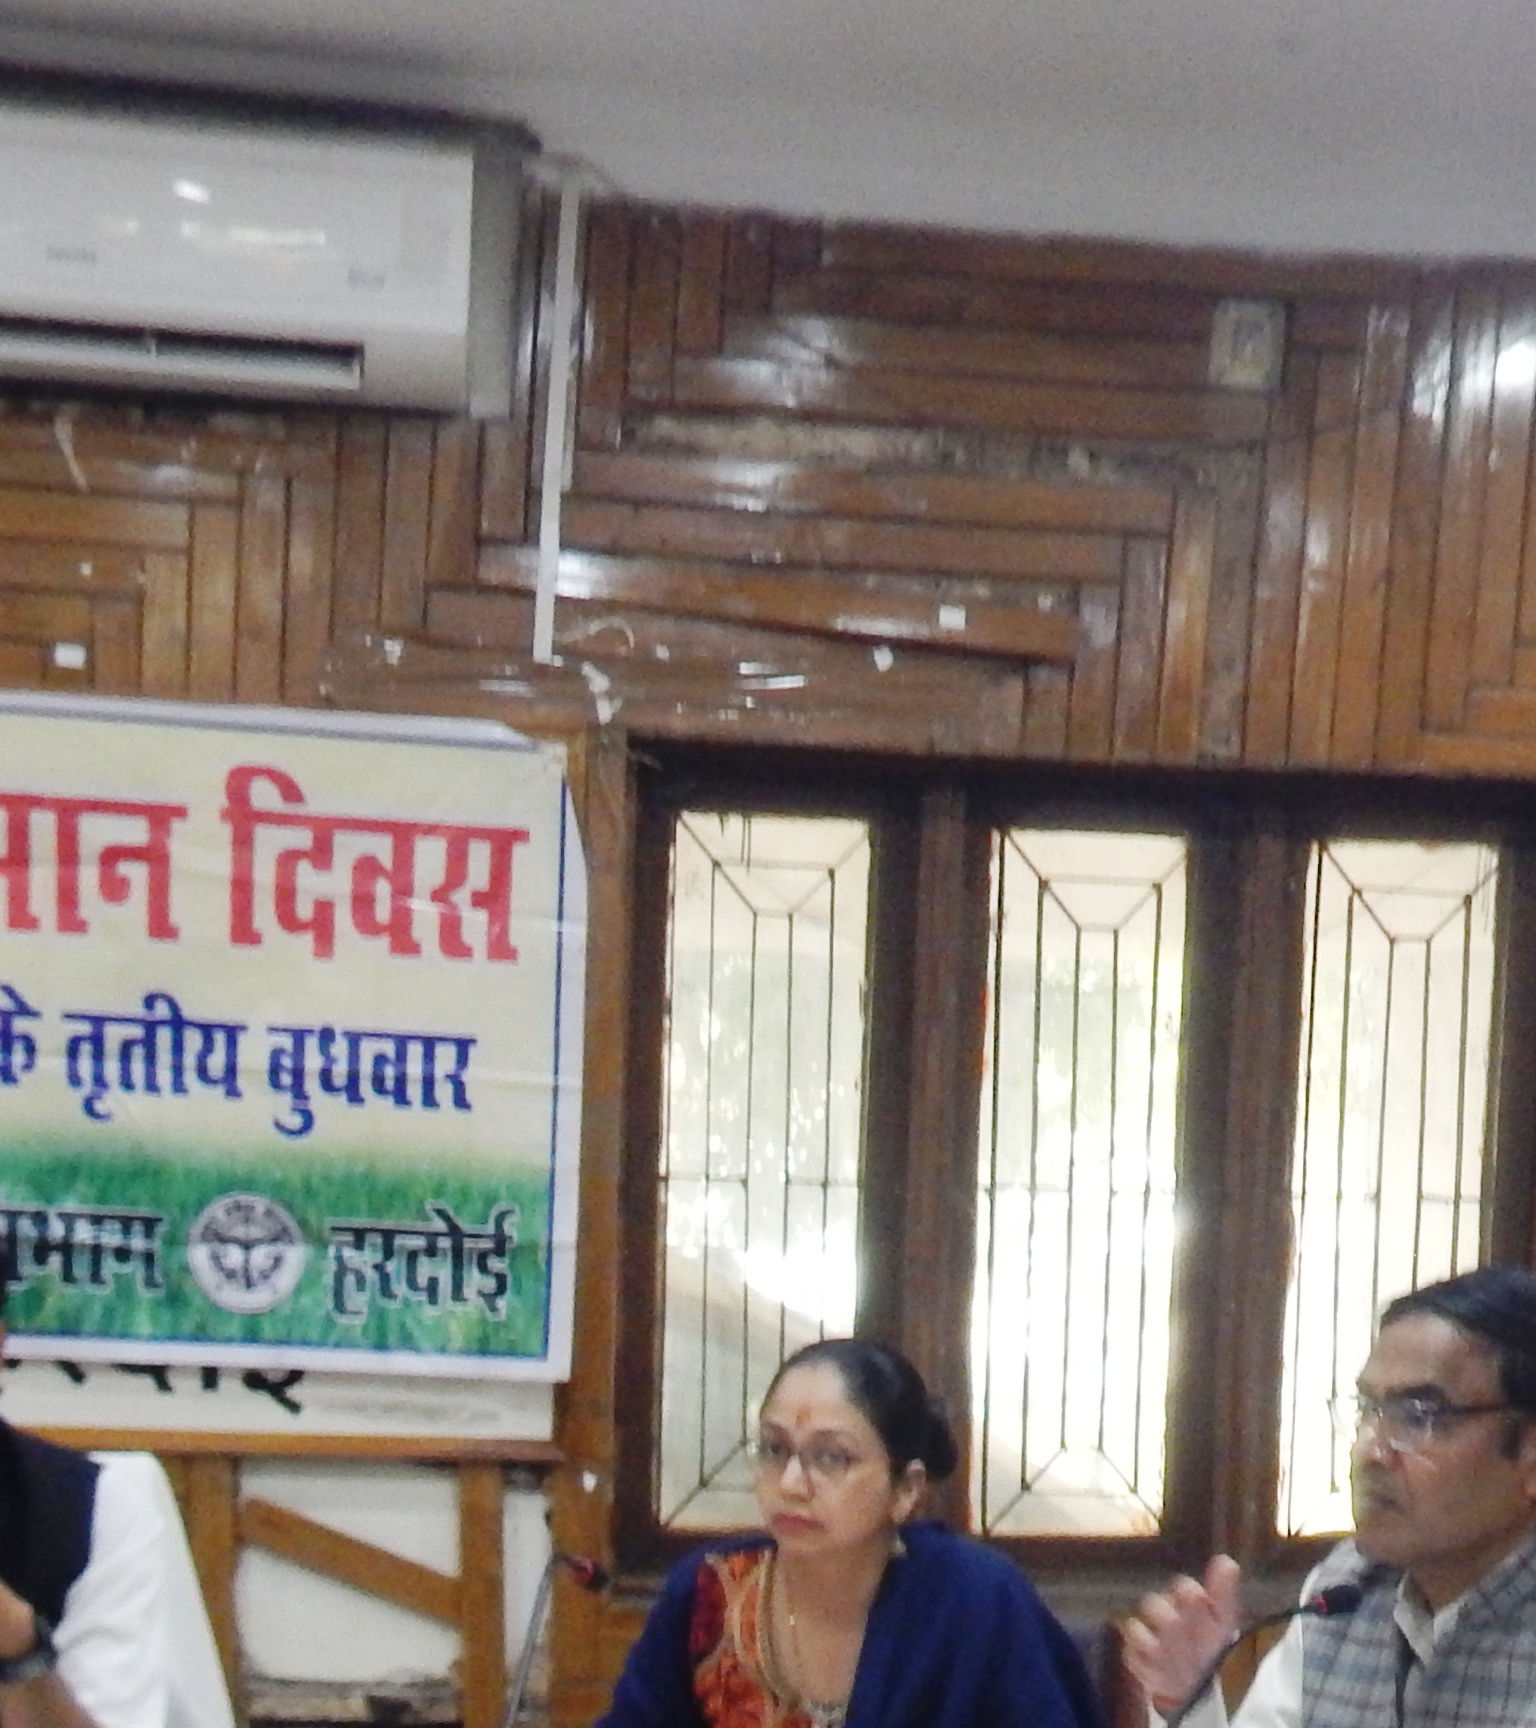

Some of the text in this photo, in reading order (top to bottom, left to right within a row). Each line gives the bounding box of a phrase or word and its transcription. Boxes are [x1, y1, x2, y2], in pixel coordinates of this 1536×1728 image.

[221, 765, 529, 961] दिवस
[64, 993, 246, 1122] तृतीय
[267, 1026, 477, 1137] बुधवार
[329, 1207, 515, 1314] हरदोई
